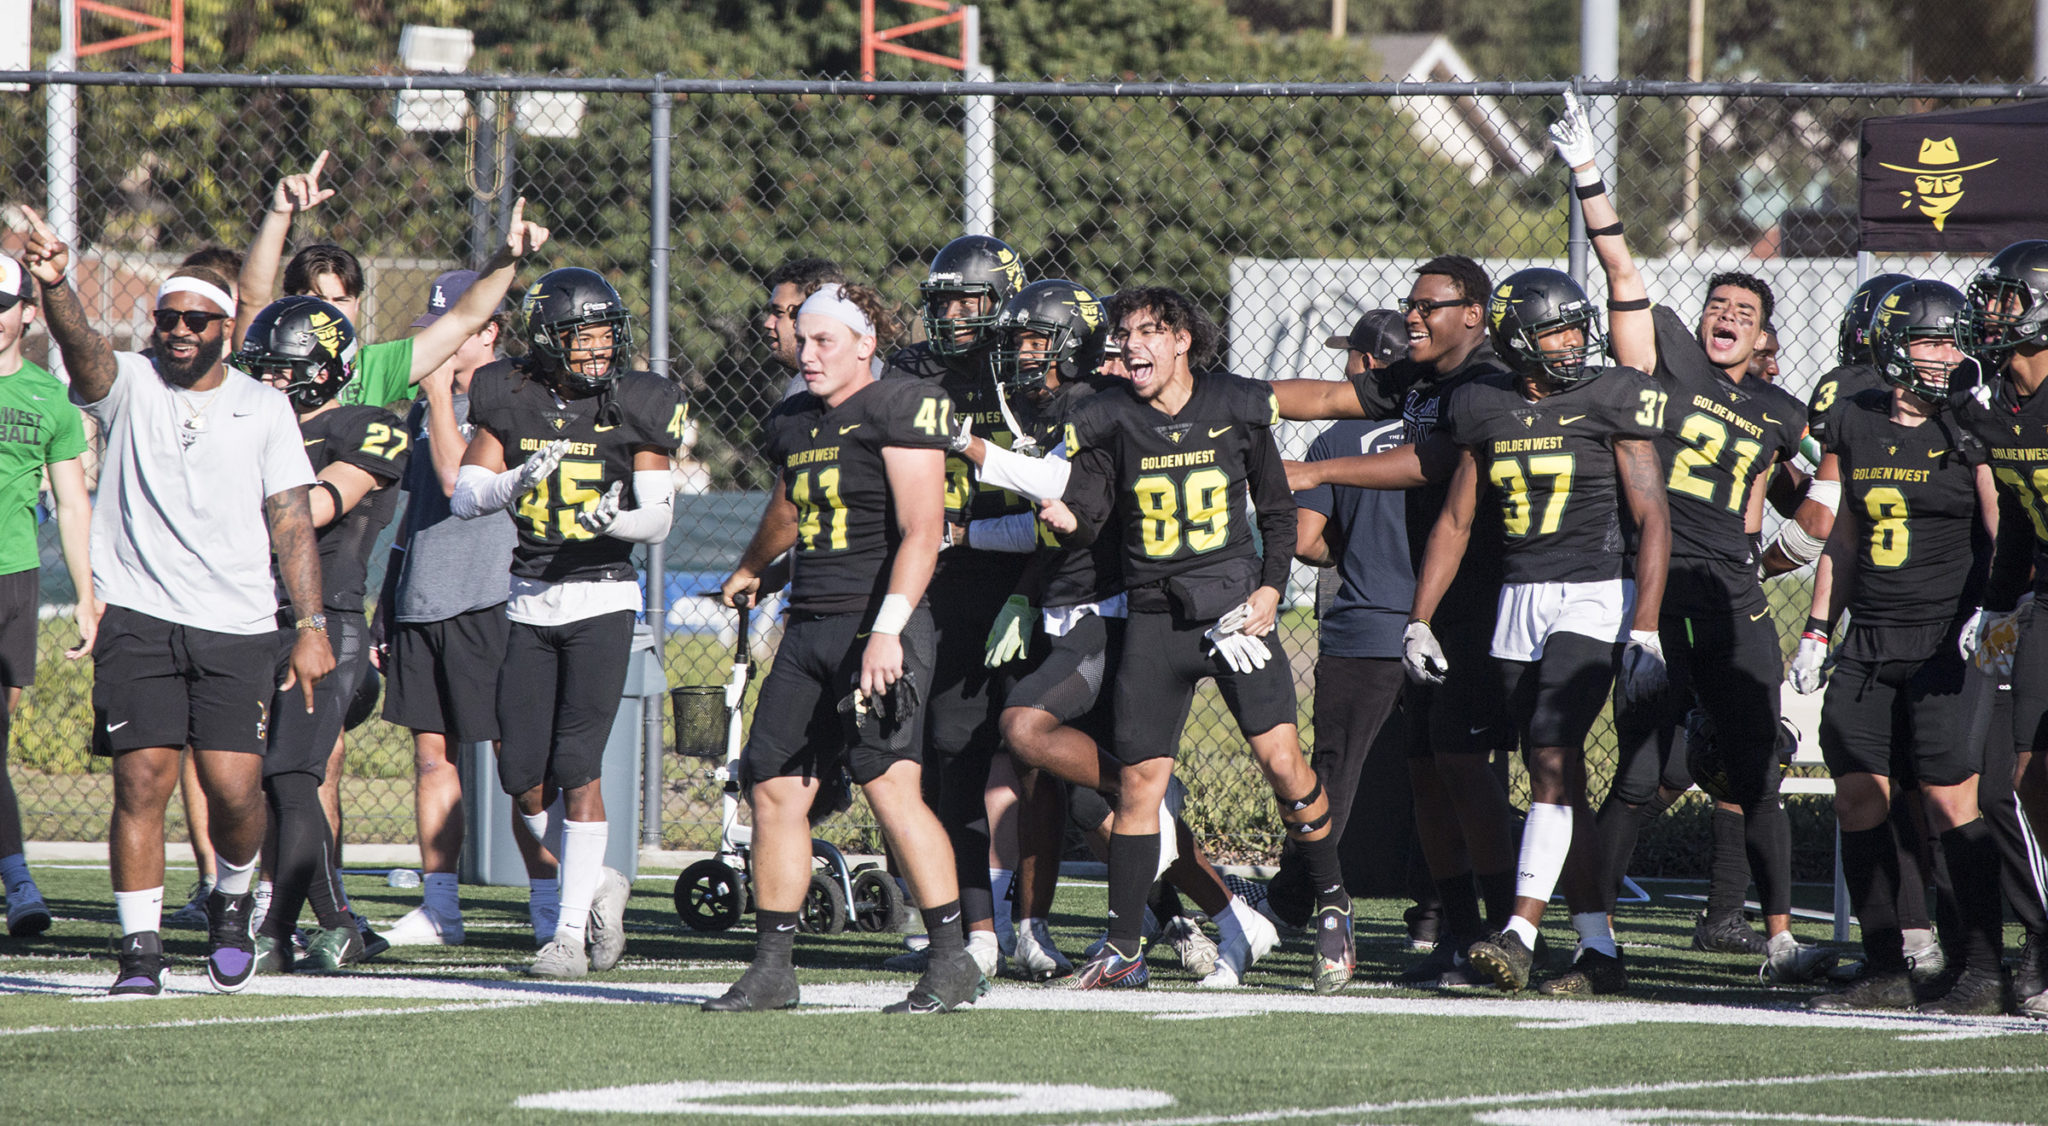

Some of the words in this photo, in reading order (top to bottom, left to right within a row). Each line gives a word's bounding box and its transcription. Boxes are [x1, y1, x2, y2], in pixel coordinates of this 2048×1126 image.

[432, 285, 446, 307] LA
[913, 397, 951, 437] 41
[975, 411, 1006, 425] WES
[360, 421, 409, 462] 27
[1141, 453, 1184, 470] GOLDEN
[1183, 449, 1216, 466] WEST
[1494, 438, 1532, 454] GOLDEN
[1532, 435, 1564, 450] WEST
[1666, 411, 1764, 514] 21
[1852, 466, 1894, 481] GOLDEN
[1892, 467, 1931, 483] WEST
[791, 464, 850, 554] 41
[1131, 466, 1230, 560] 89
[1488, 452, 1576, 538] 37
[1863, 484, 1912, 568] 8
